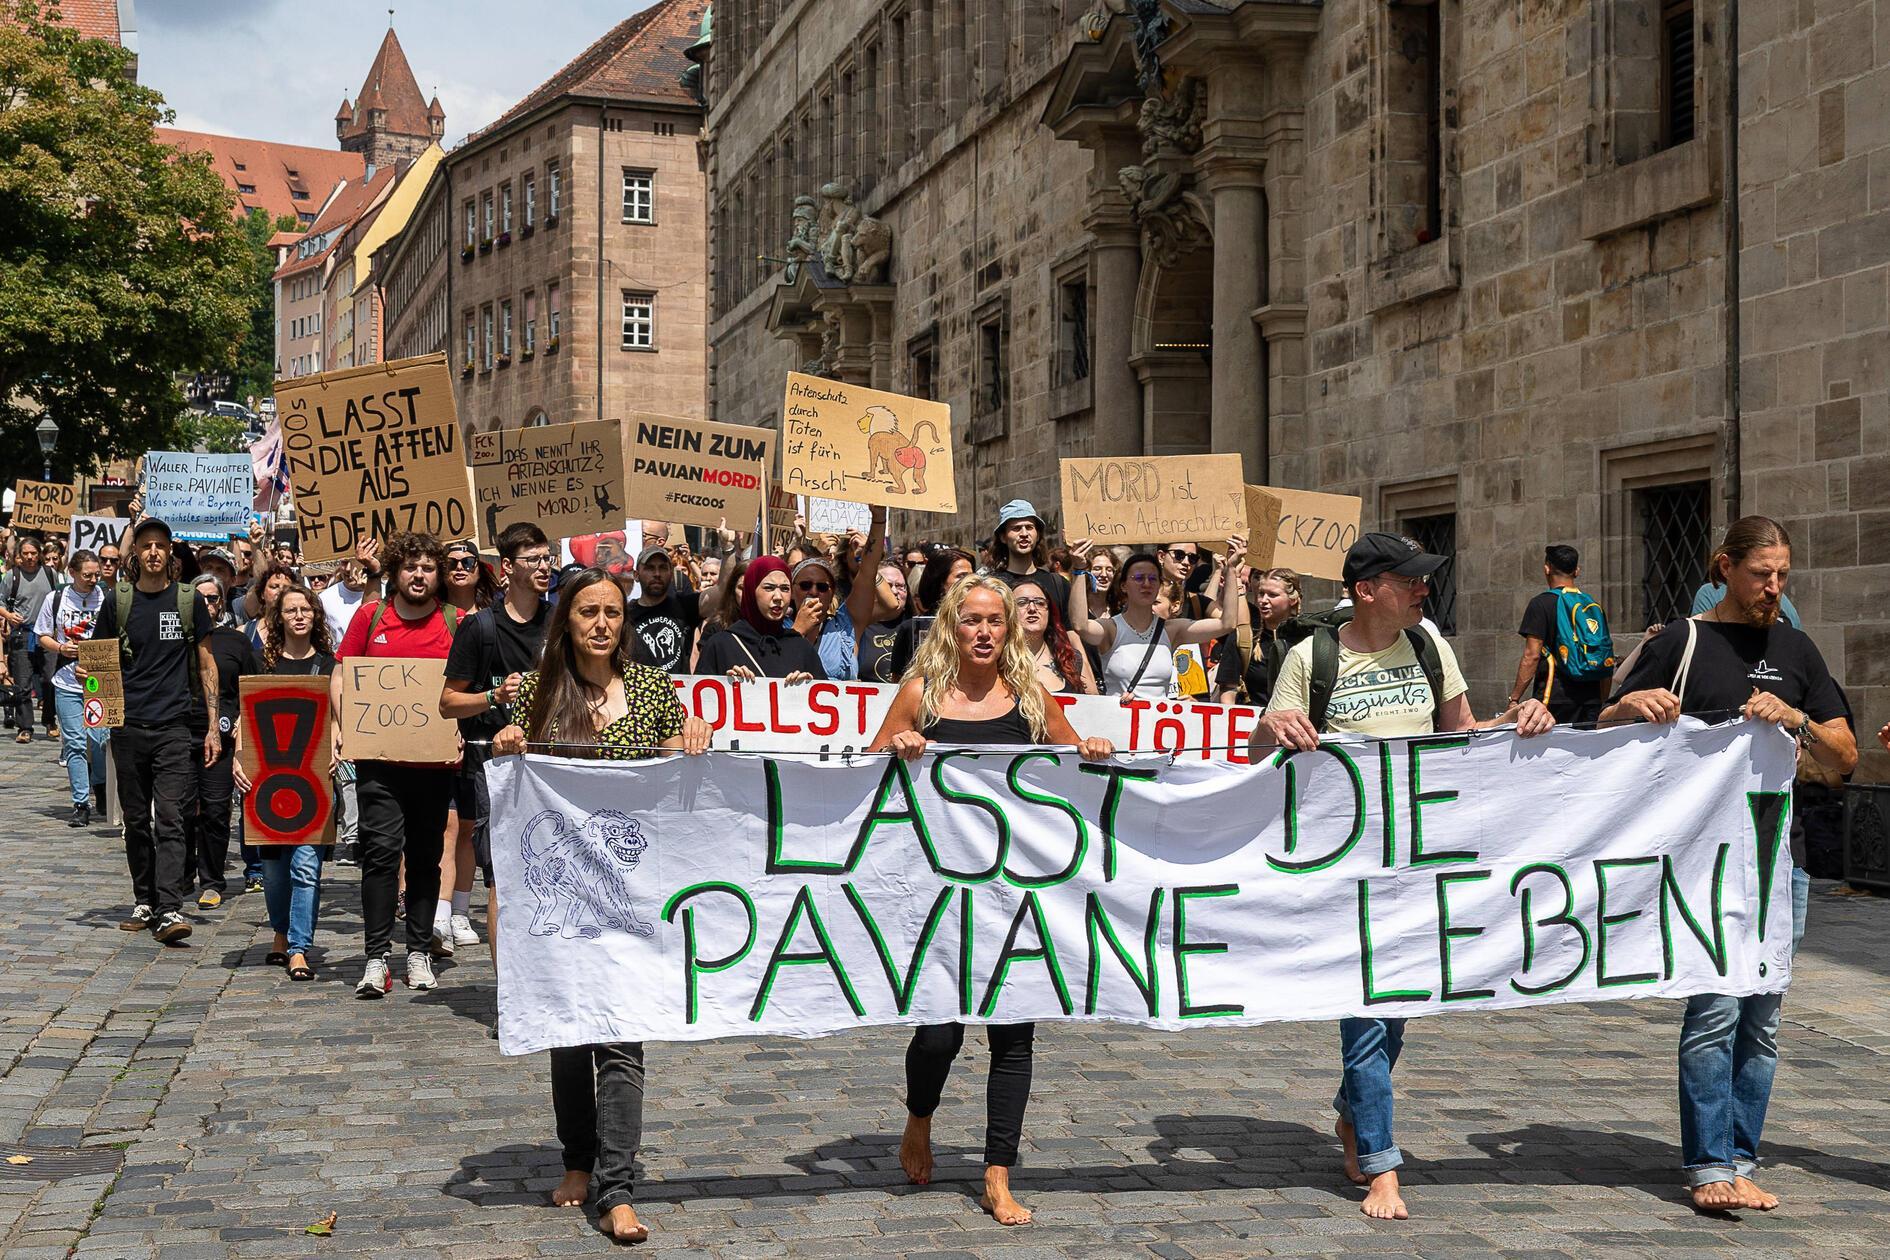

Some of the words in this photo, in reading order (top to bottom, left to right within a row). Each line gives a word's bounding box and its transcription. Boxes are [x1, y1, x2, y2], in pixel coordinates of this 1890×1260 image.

[790, 382, 848, 405] Artenschutz
[316, 386, 421, 439] LASST
[788, 403, 819, 418] durch
[788, 419, 822, 438] Töten
[318, 439, 366, 475] DIE
[374, 423, 453, 467] AFFEN
[475, 435, 495, 449] FCK
[504, 448, 529, 463] DAS
[535, 441, 573, 460] NENNT
[581, 439, 601, 454] IHR
[636, 422, 703, 454] NEIN
[708, 433, 767, 462] ZUM
[788, 440, 804, 454] ist
[508, 453, 604, 481] ARTENSCHUTZ?
[633, 457, 762, 491] PAVIANMORD!
[788, 467, 847, 491] Arsch!
[22, 483, 74, 506] MORD
[358, 465, 410, 504] AUS
[478, 486, 501, 503] ICH
[511, 479, 558, 498] NENNE
[566, 477, 585, 492] ES
[1069, 461, 1161, 503] MORD
[1171, 469, 1199, 501] ist
[37, 502, 53, 514] im
[171, 496, 193, 507] wird
[537, 496, 589, 519] MORD!
[664, 491, 726, 510] #FCKZOOS
[15, 501, 72, 529] Tiergarten
[1085, 512, 1128, 537] kein
[648, 616, 682, 638] LIBERATION
[353, 664, 422, 692] FCK
[353, 702, 430, 735] ZOOS
[763, 750, 1159, 889] LASST
[1264, 737, 1480, 874] DIE
[661, 880, 1245, 1025] PAVIANE
